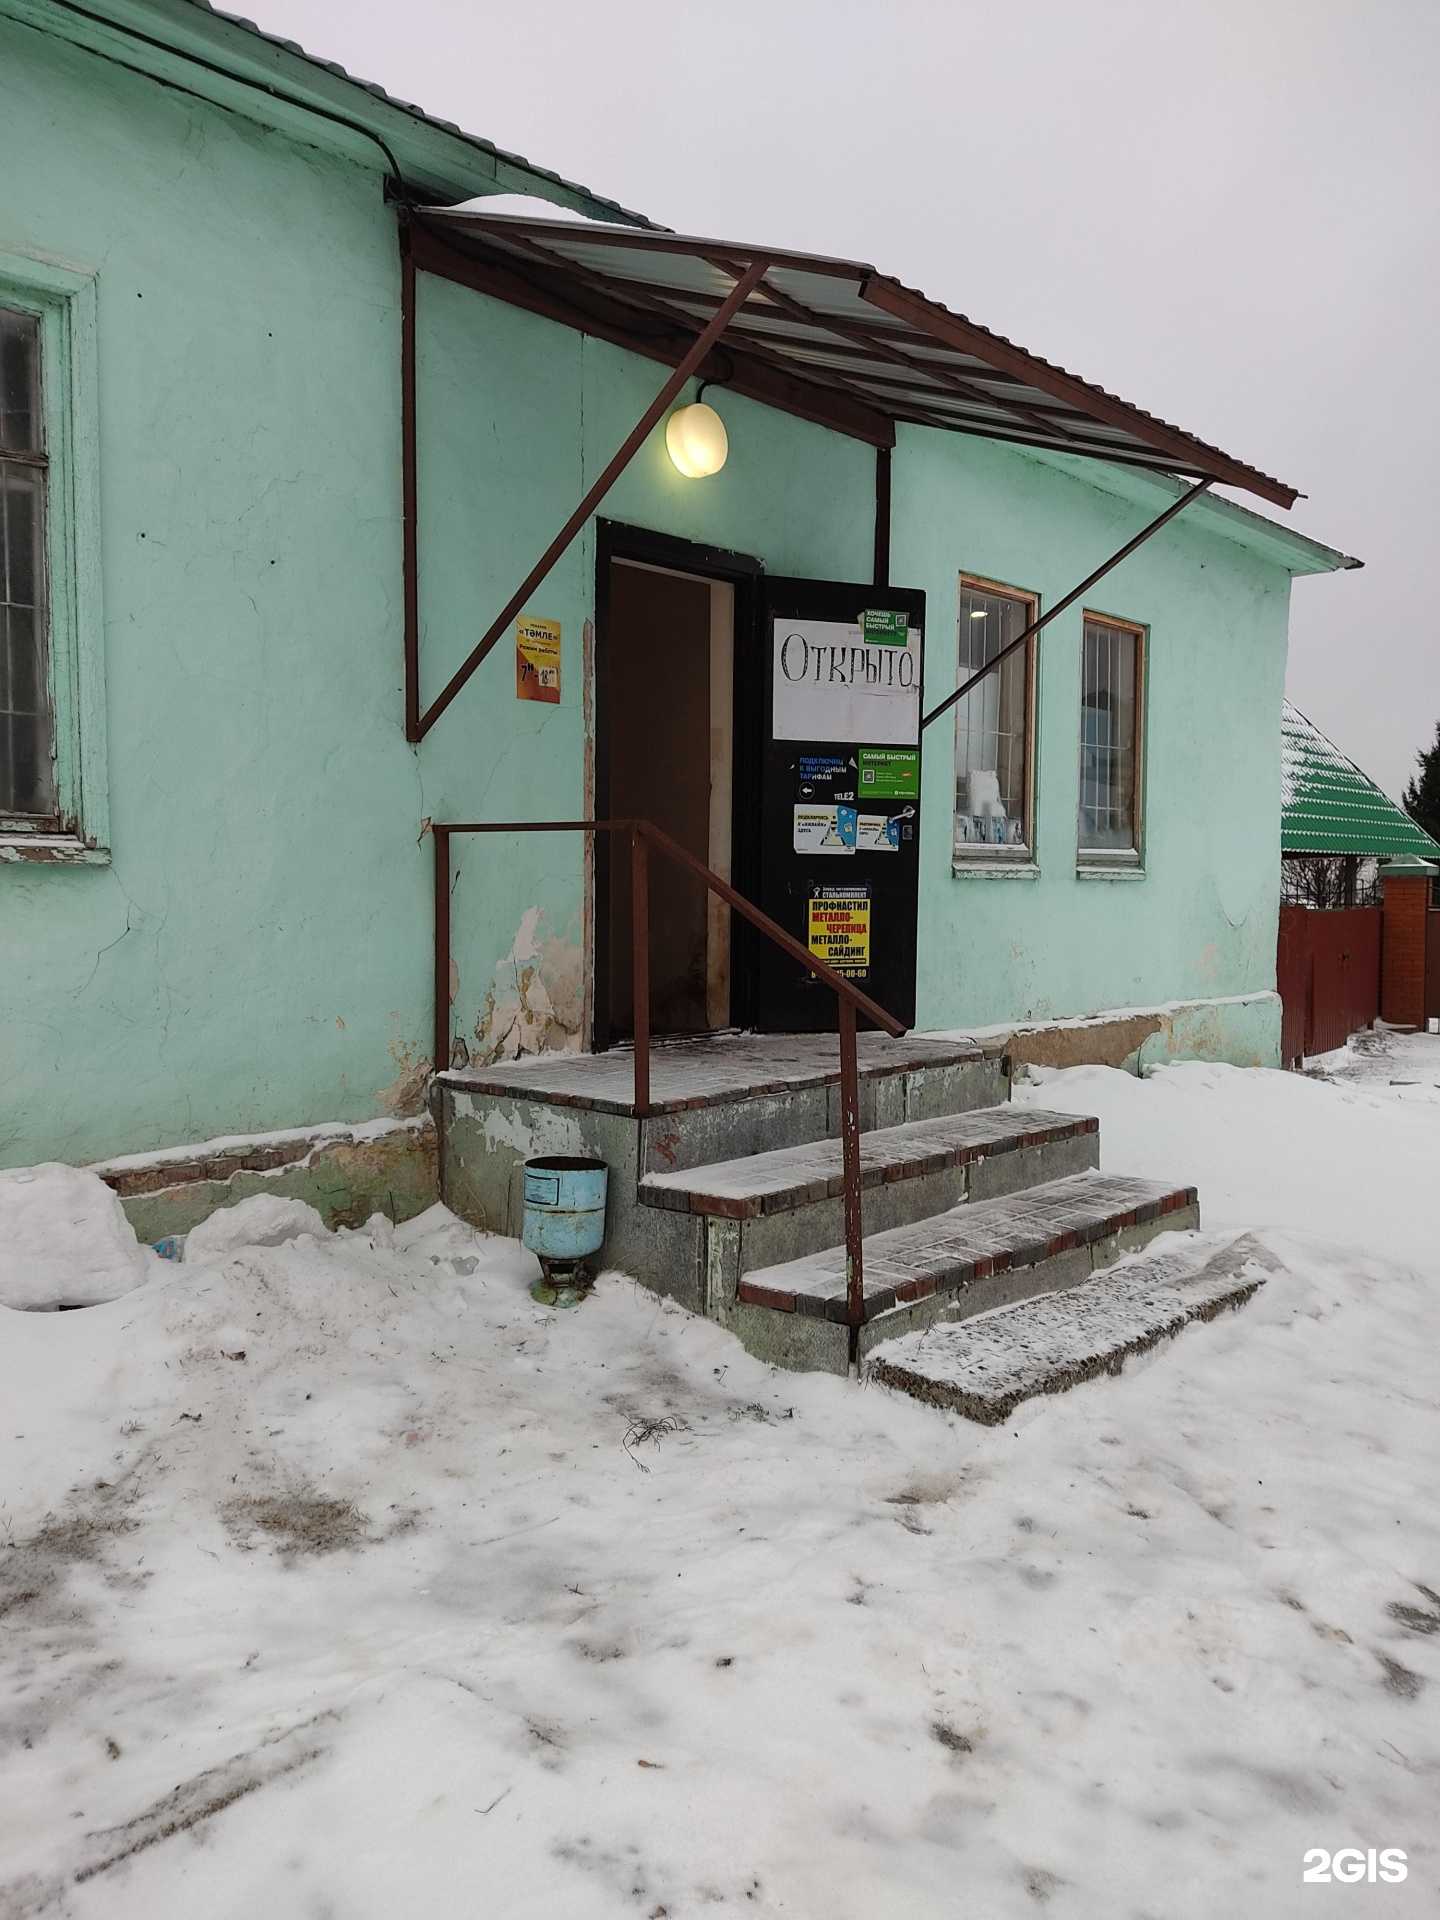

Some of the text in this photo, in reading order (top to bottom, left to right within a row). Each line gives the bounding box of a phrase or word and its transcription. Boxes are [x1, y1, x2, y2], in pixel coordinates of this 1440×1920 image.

[866, 616, 889, 624] САМЫЙ
[865, 622, 895, 631] БЫСТРЫЙ
[863, 752, 916, 761] САМЫЙ БЫСТРЫЙ
[834, 792, 855, 801] TELE2
[812, 901, 868, 911] ПРОФНАСТИЛ
[812, 912, 853, 922] МЕТАЛЛО-
[826, 924, 867, 934] ЧЕРЕПИЦА
[811, 935, 853, 945] МЕТАЛЛО-
[828, 945, 865, 957] САЙДИНГ
